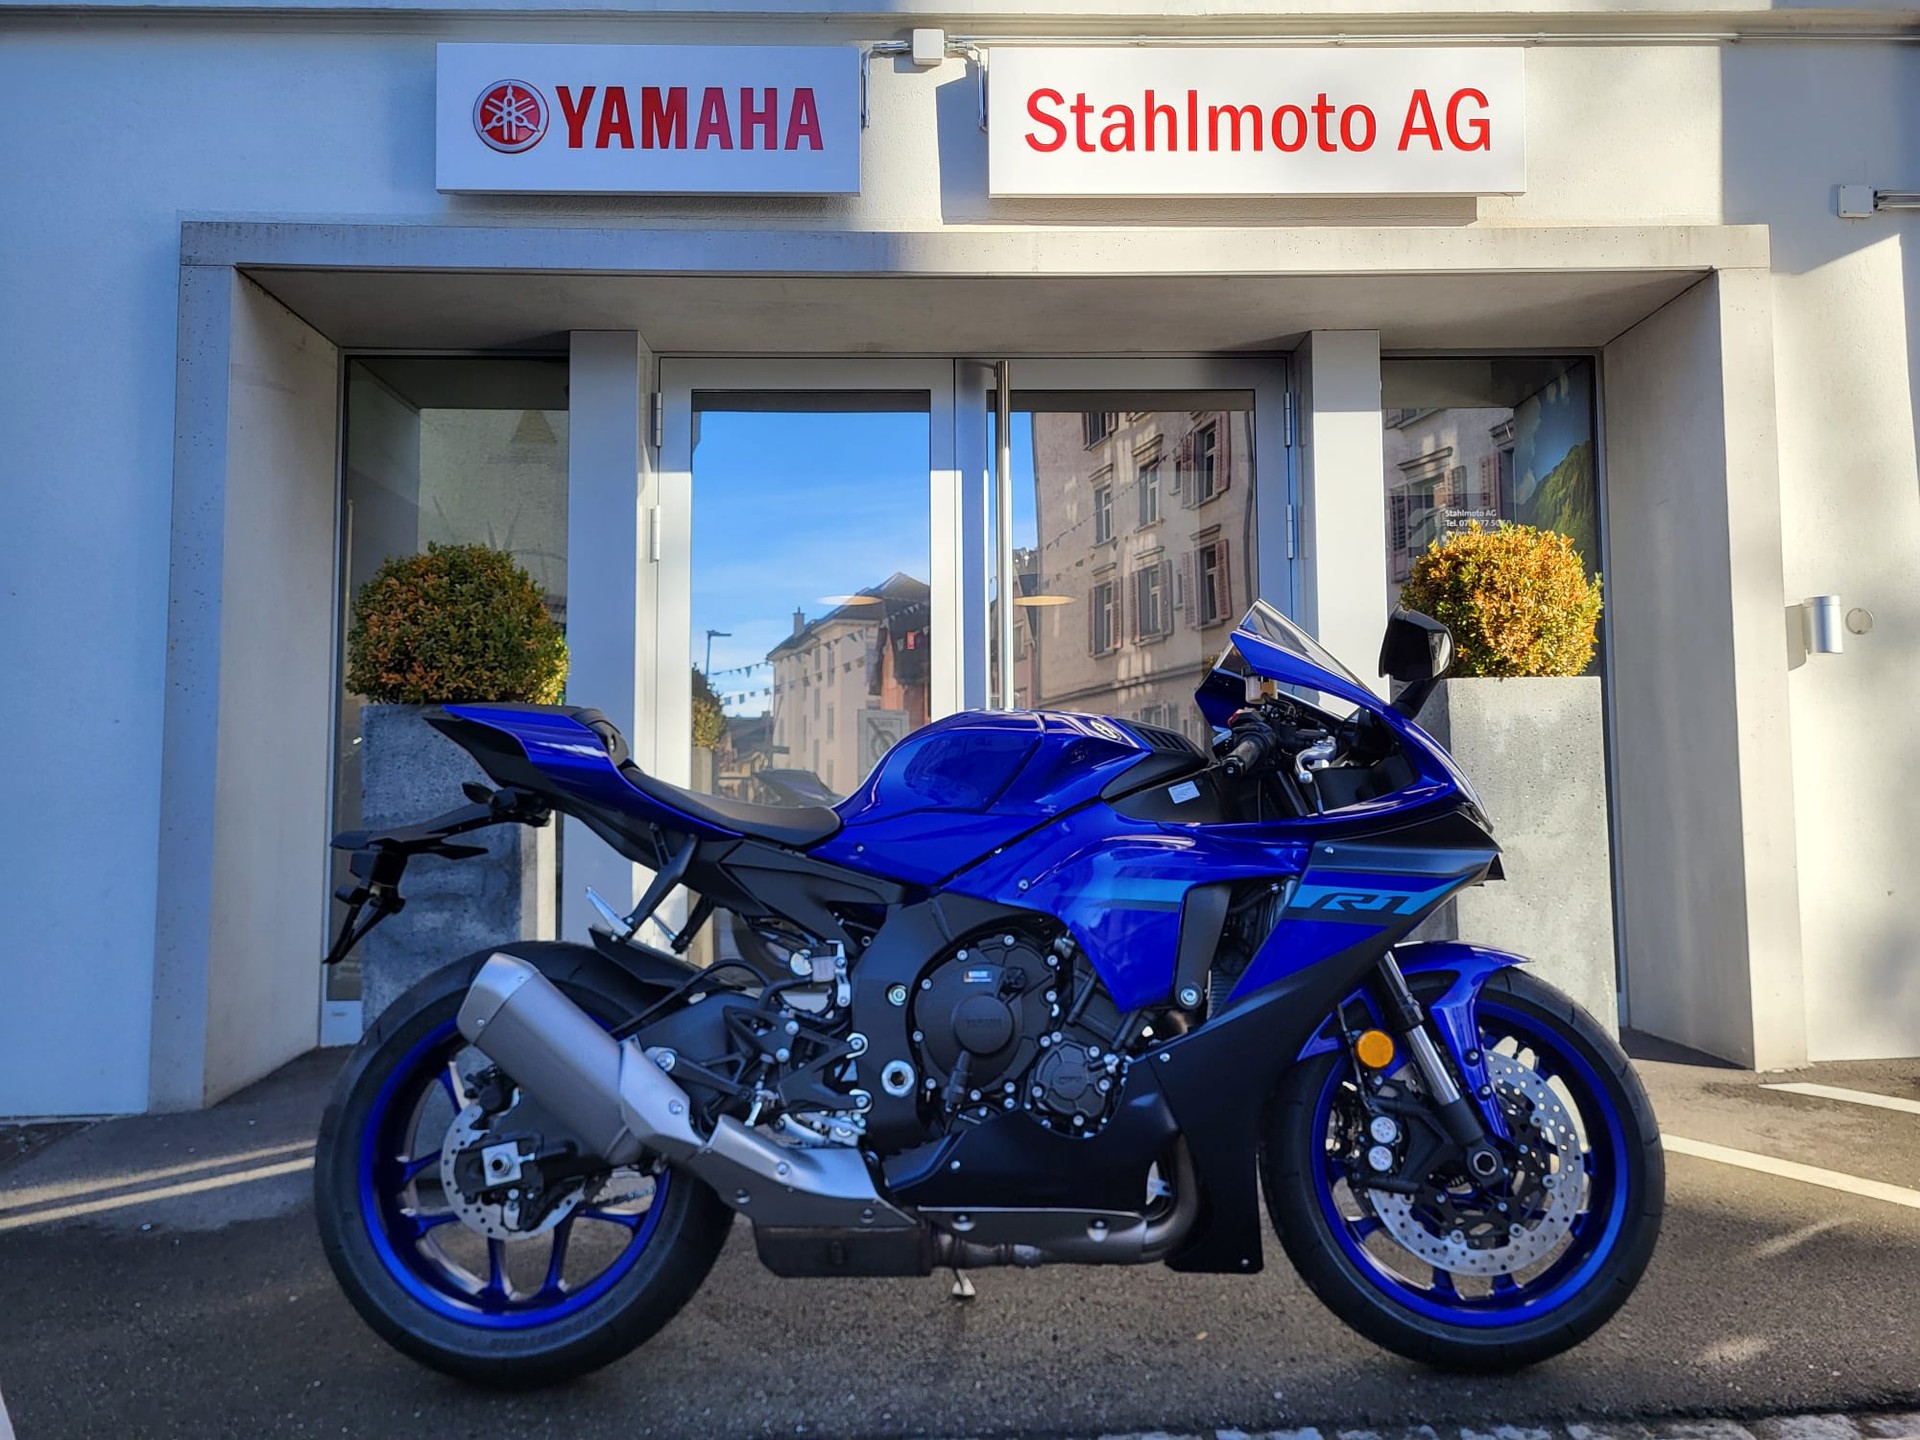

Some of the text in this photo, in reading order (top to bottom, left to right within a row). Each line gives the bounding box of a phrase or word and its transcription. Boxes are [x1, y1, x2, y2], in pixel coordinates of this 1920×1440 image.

[556, 86, 824, 150] YAMAHA
[1025, 88, 1491, 153] Stahlmoto AG
[1445, 509, 1497, 517] Stahlmoto AG
[1309, 892, 1411, 915] R1
